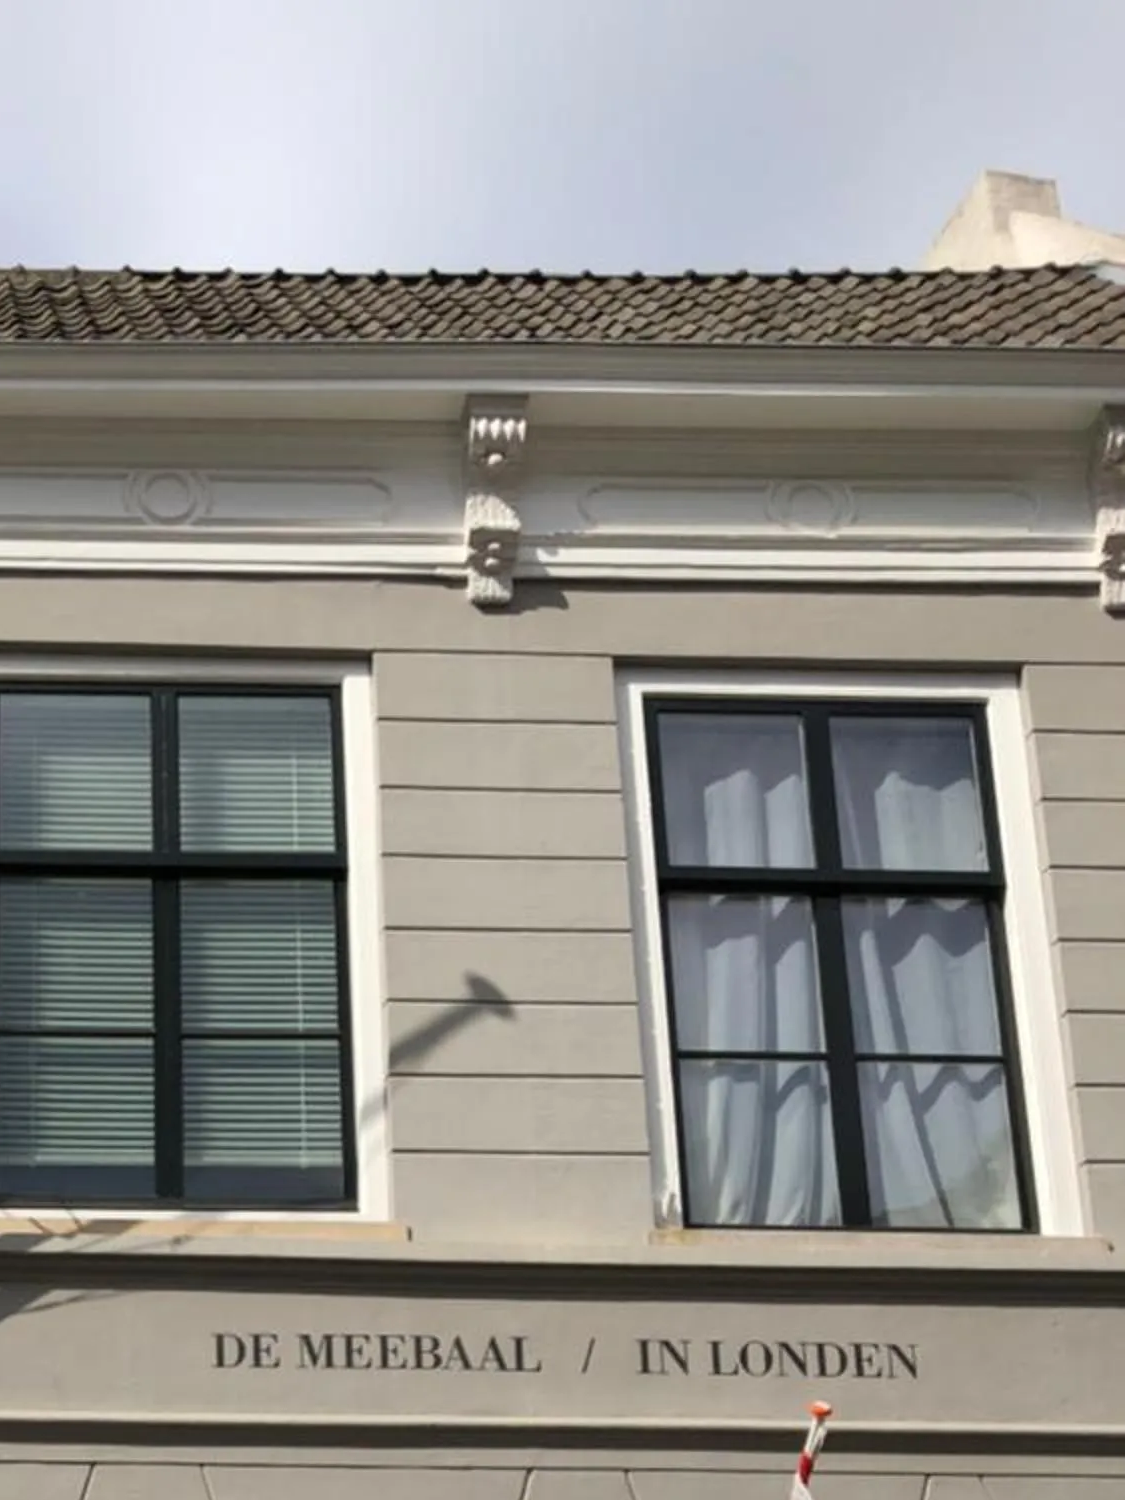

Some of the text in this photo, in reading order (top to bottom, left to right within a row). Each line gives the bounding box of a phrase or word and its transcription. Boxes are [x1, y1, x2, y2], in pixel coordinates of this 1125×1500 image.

[213, 1332, 920, 1380] DE MEEBAAL / IN LONDEN
